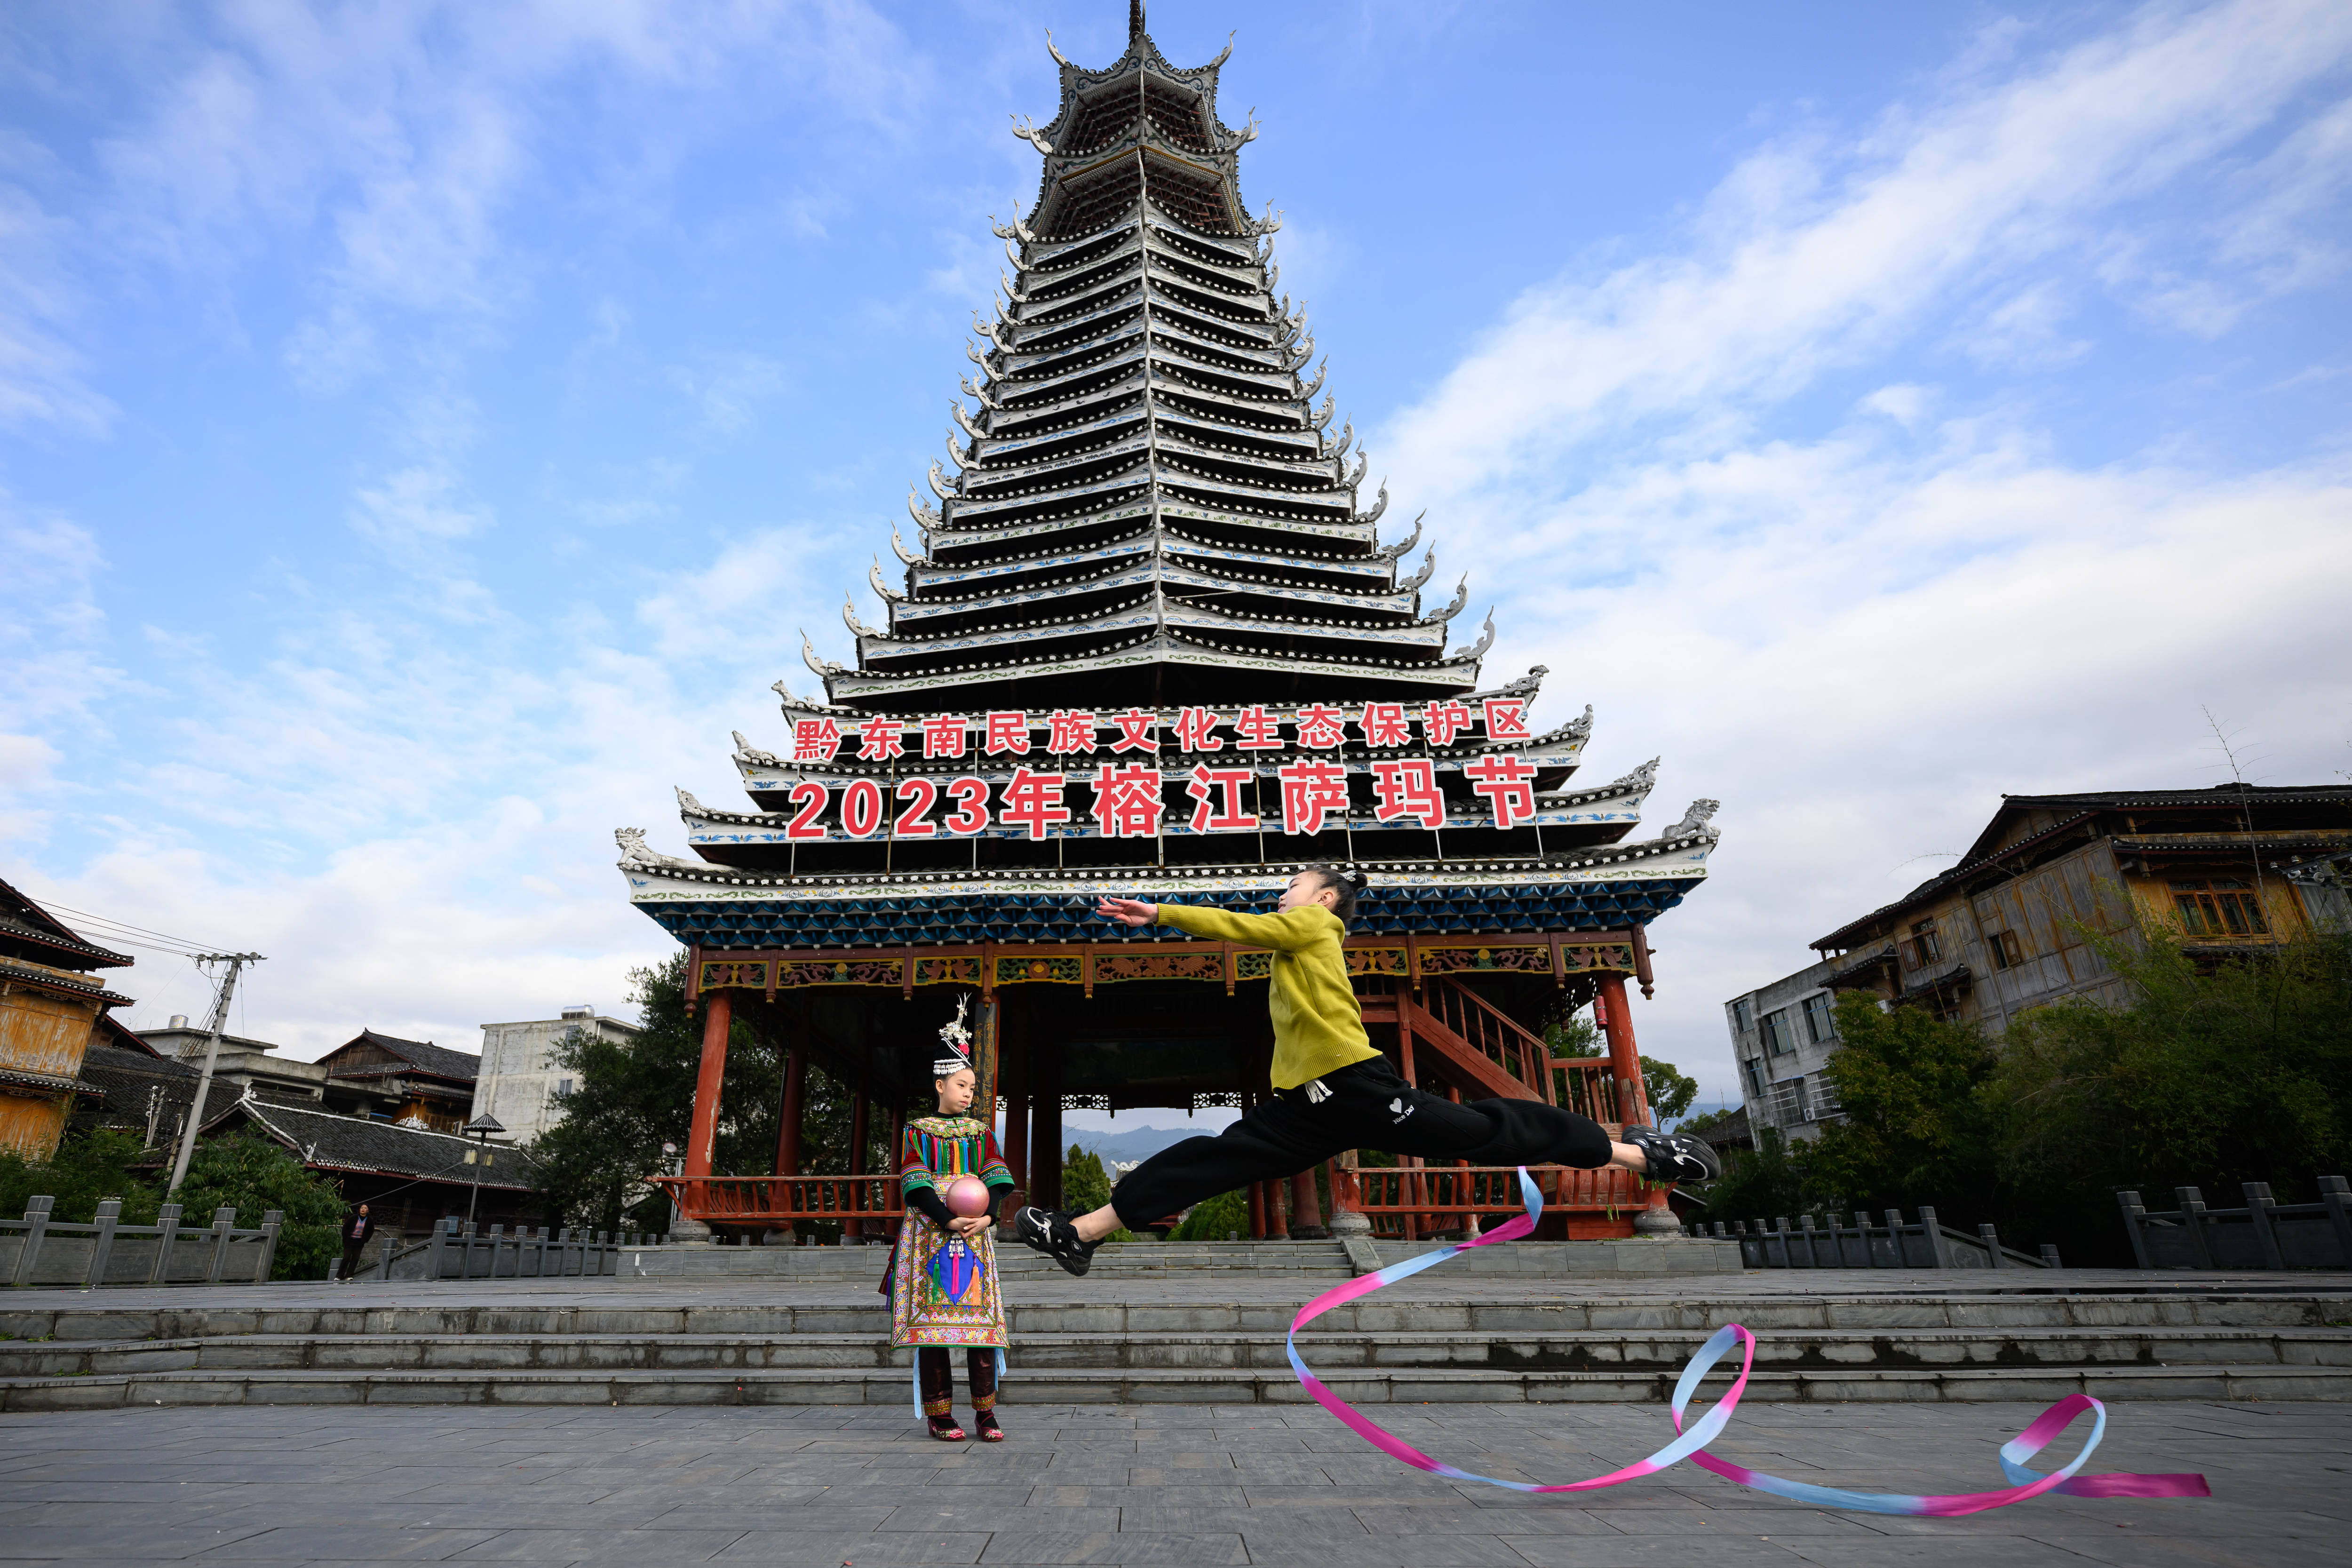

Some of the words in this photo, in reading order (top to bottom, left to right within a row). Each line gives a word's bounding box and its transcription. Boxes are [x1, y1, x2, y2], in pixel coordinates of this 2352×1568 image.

[794, 700, 1531, 759] 黔东南民族文化生态保护区
[788, 756, 1534, 838] 2023年榕江萨玛节
[1392, 1114, 1406, 1124] Nice
[1405, 1105, 1414, 1116] Day
